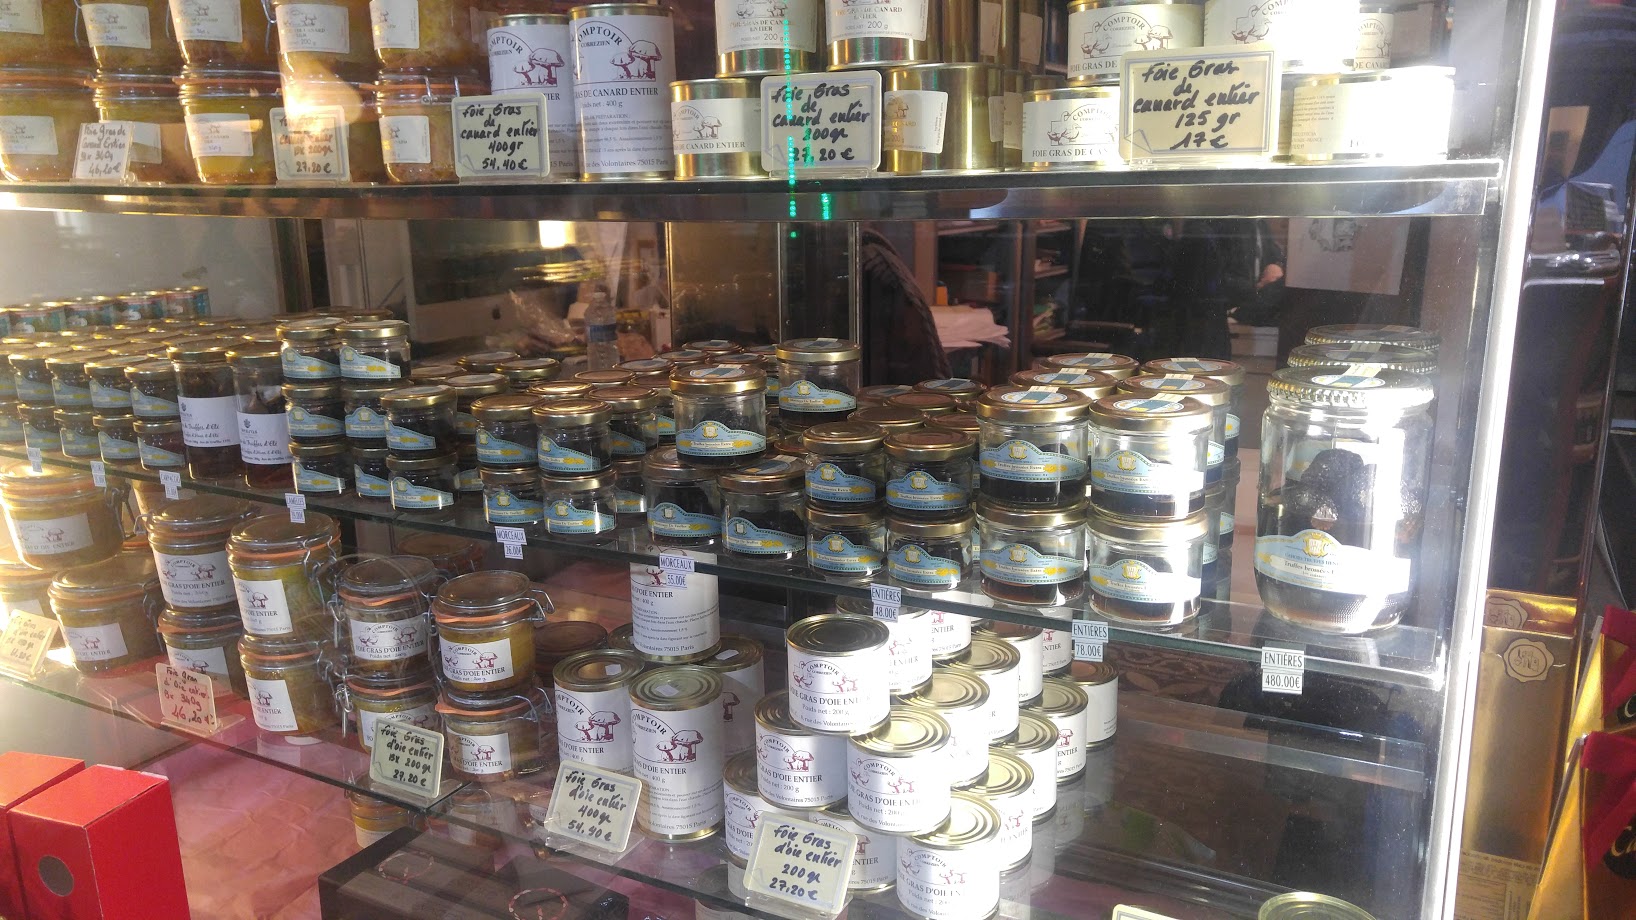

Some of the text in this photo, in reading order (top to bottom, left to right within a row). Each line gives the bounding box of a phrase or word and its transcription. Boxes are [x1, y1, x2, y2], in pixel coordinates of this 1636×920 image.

[1103, 16, 1145, 31] COMPTOIR
[1082, 60, 1117, 70] GRAS DE
[592, 88, 628, 97] CANARD
[630, 87, 659, 96] ENTIER
[1174, 112, 1209, 128] 125
[686, 142, 714, 150] CANARD
[496, 530, 525, 541] MORCEAUX
[660, 558, 693, 570] MORCEAUX
[667, 574, 686, 586] 55.00€
[874, 607, 897, 620] 48.00€
[1076, 644, 1102, 657] 78.00€
[482, 666, 506, 676] ENTIER
[806, 663, 840, 676] COMPTOIR
[1264, 673, 1300, 689] 480.00€
[800, 692, 842, 706] GRAS D'OIE
[404, 758, 420, 769] 200
[480, 760, 502, 768] ENTIER
[864, 762, 896, 776] COMPTOIR
[660, 767, 687, 775] ENTIER
[772, 772, 792, 782] D'OIE
[856, 790, 898, 806] GRAS D'OIE
[802, 832, 832, 850] Gras
[914, 853, 946, 868] COMPTOIR
[782, 864, 806, 878] 200
[906, 878, 924, 892] GRAS
